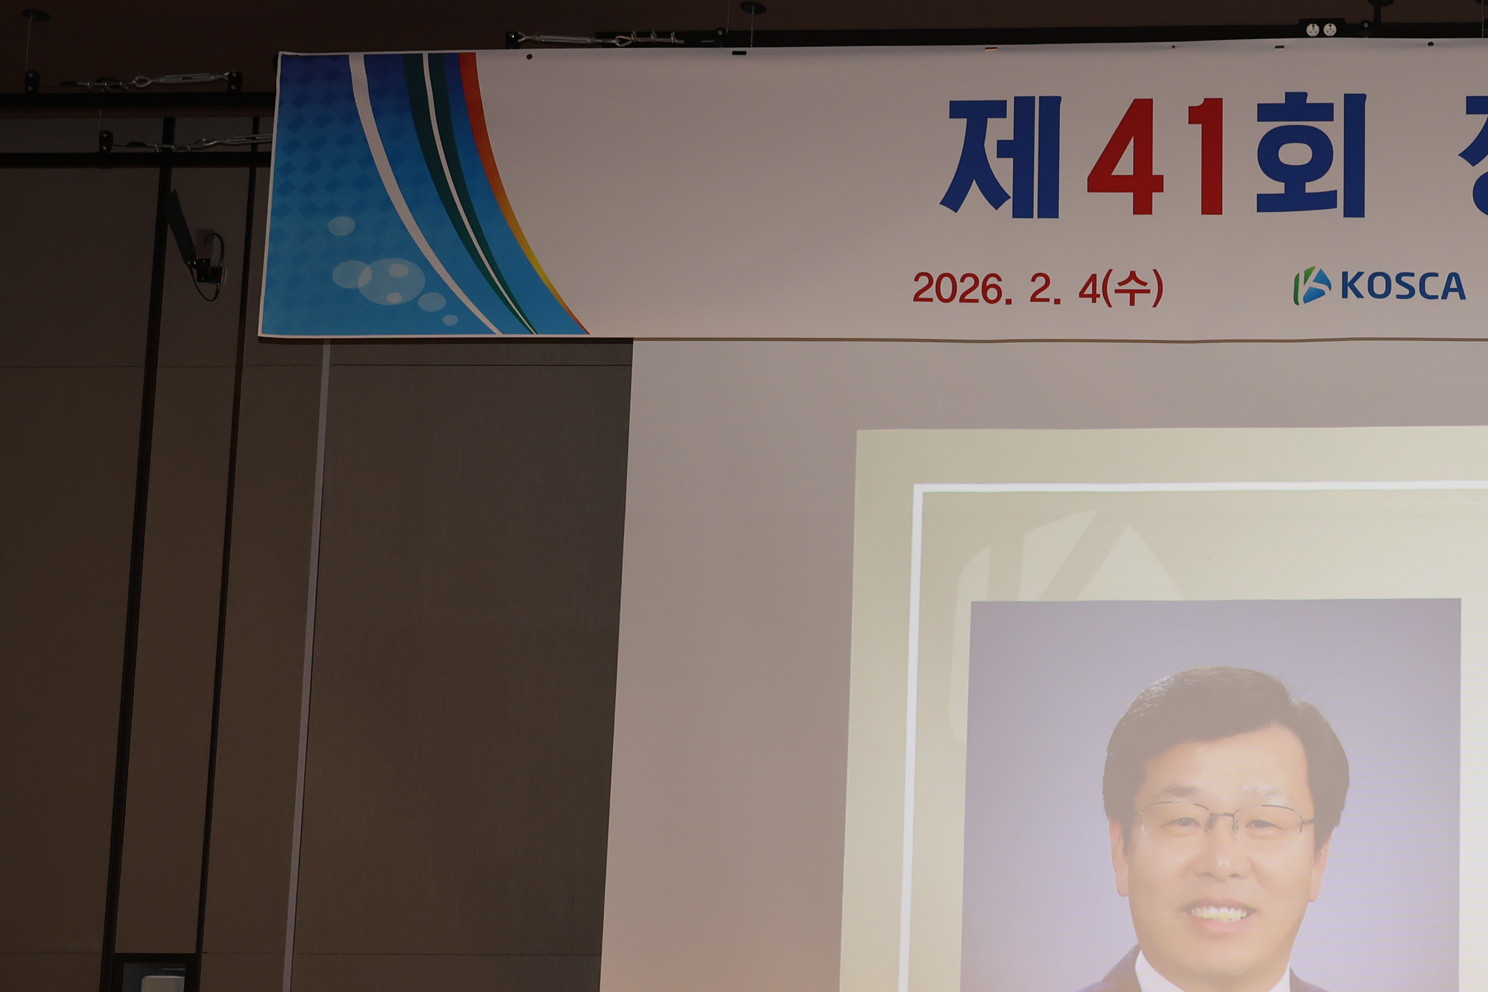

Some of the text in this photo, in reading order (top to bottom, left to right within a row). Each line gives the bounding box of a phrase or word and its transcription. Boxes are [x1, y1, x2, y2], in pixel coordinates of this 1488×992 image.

[940, 91, 1367, 219] 제41회
[913, 268, 1164, 308] 2026. 2. 4(수)
[1341, 271, 1467, 301] KOSCA
